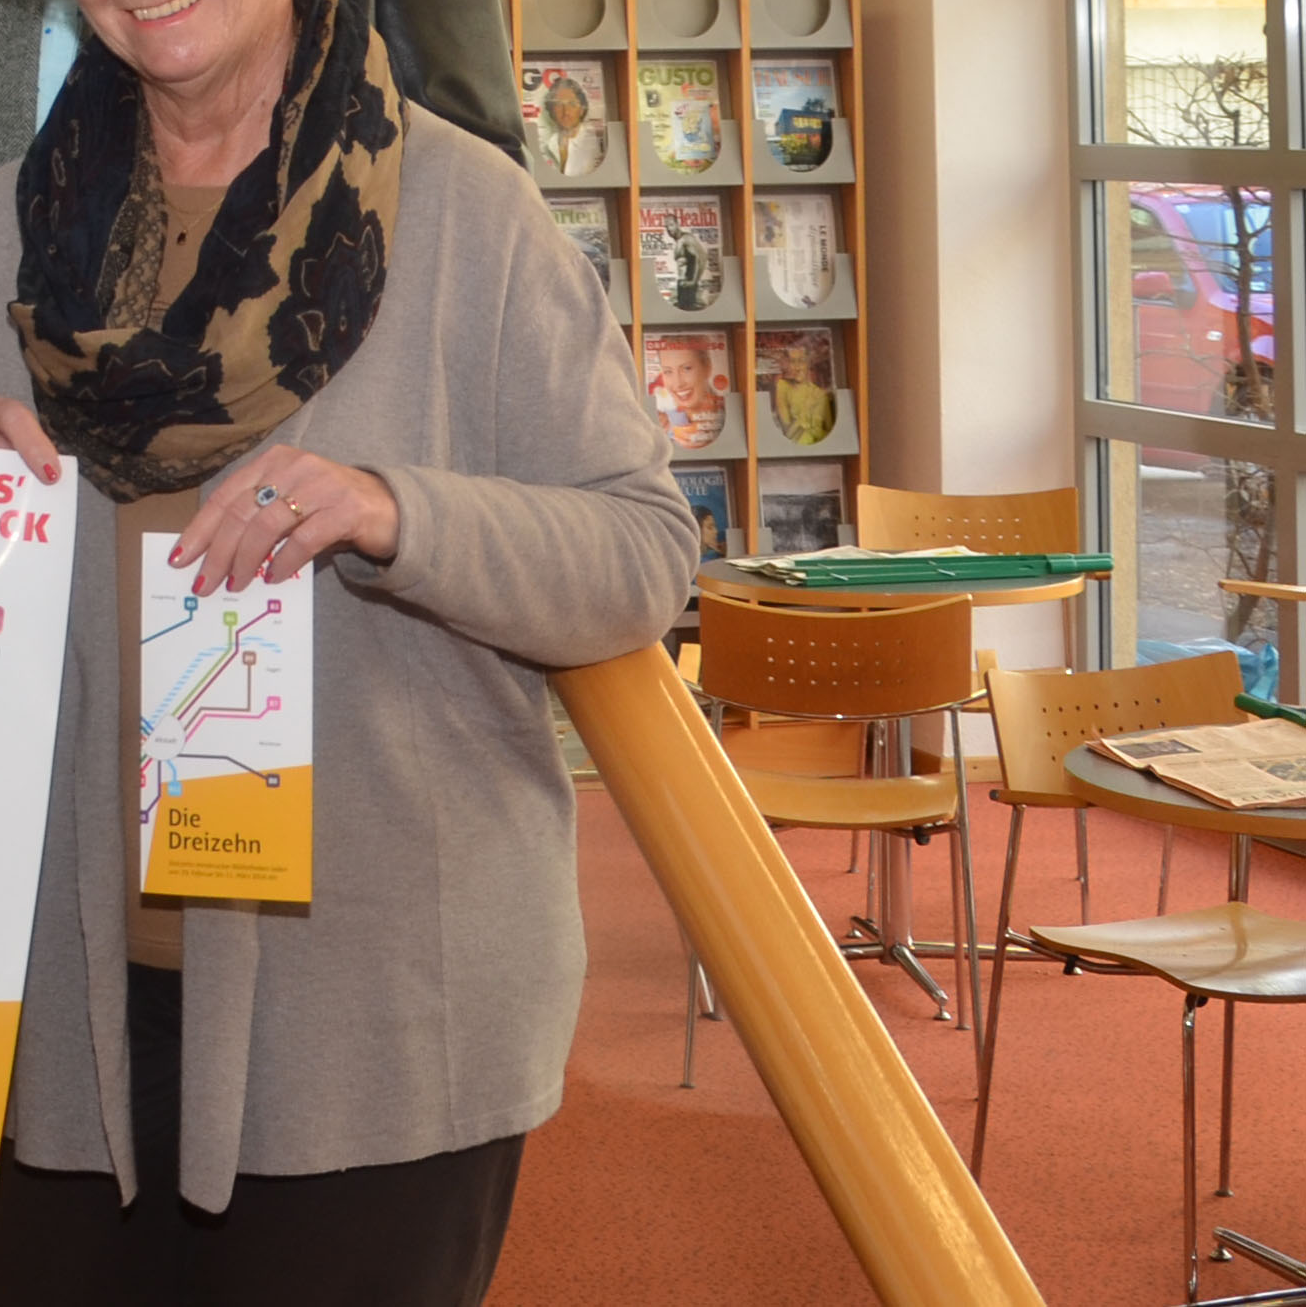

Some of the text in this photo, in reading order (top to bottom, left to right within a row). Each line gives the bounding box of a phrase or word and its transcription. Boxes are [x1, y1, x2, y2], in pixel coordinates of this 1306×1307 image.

[639, 68, 714, 87] GUSTO
[820, 239, 829, 272] MONDE
[169, 808, 201, 828] Die
[169, 832, 261, 853] Dreizehn
